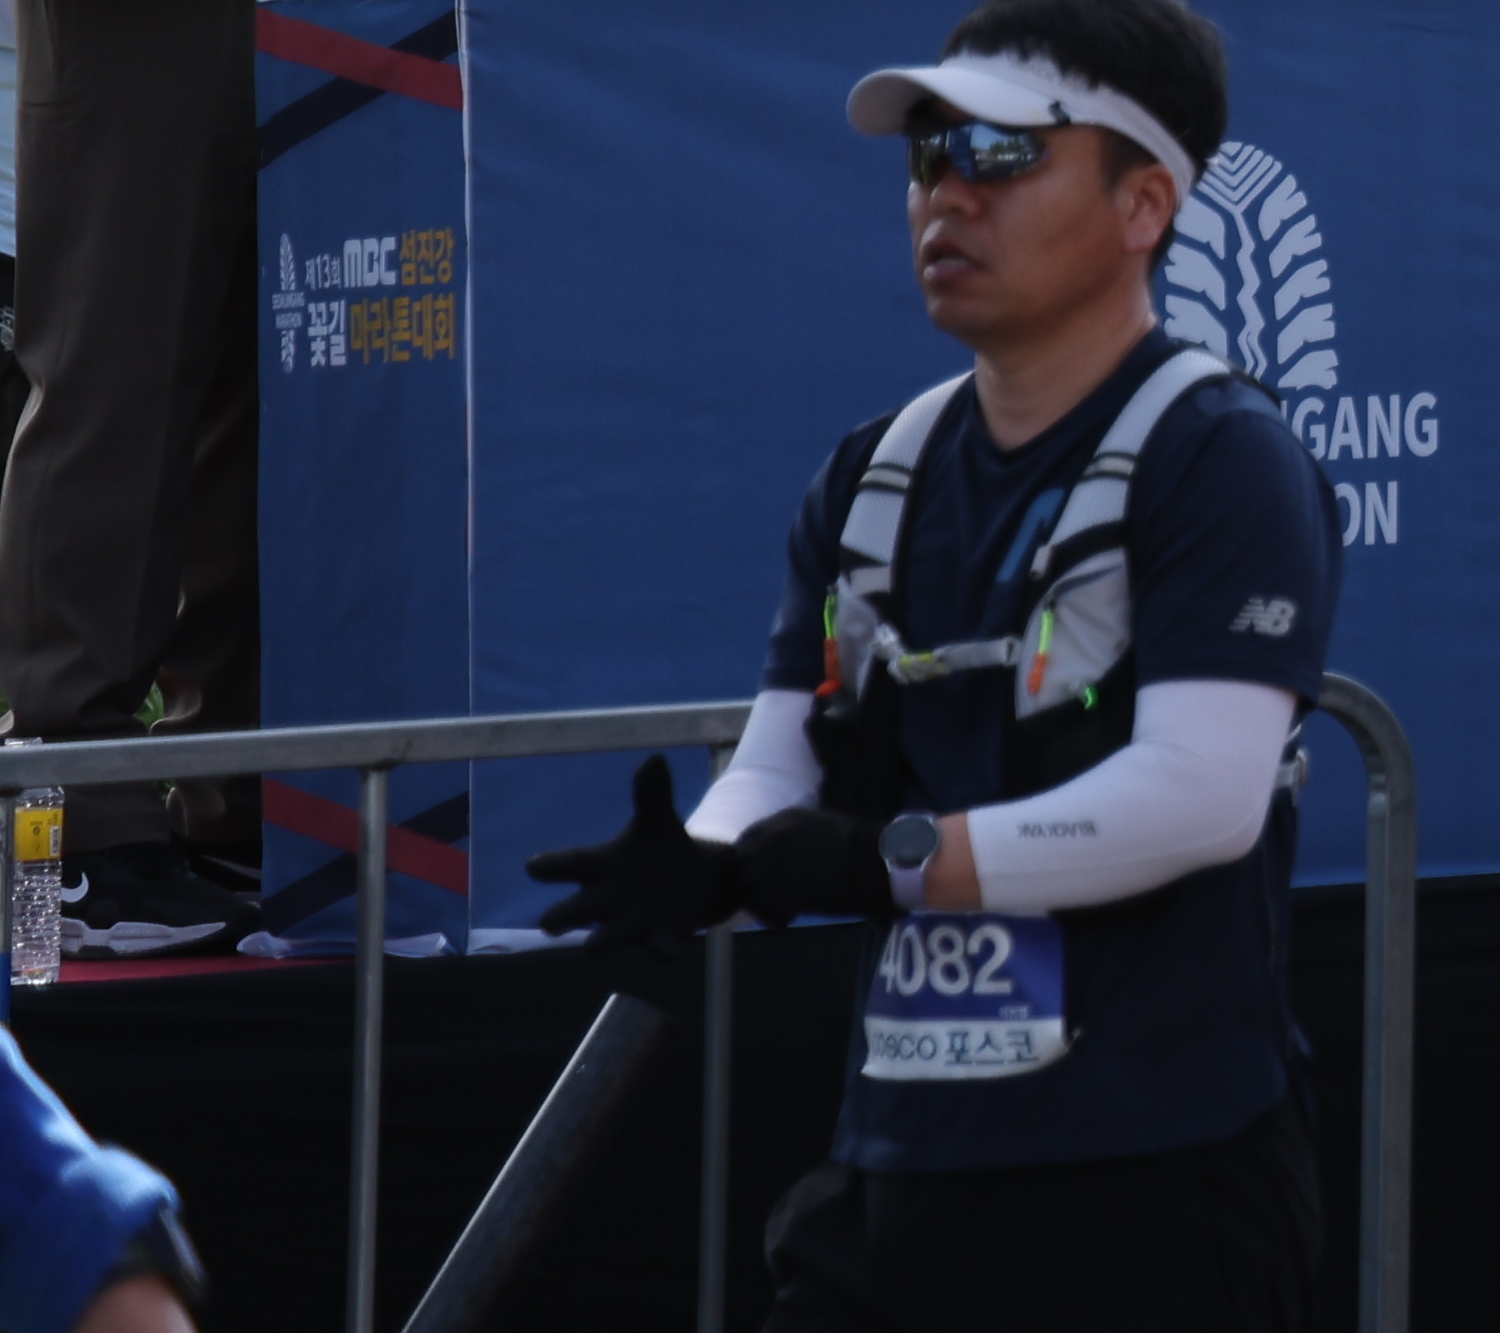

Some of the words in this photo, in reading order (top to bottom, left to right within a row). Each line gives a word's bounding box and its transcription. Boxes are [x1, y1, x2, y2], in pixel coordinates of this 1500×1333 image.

[305, 253, 341, 290] 제13회
[343, 236, 397, 289] MBC
[399, 228, 456, 286] 섬진강
[307, 299, 347, 368] 꽃길
[351, 291, 457, 365] 마라톤대회
[879, 924, 1013, 997] 4082
[946, 1031, 1039, 1067] 포스코
